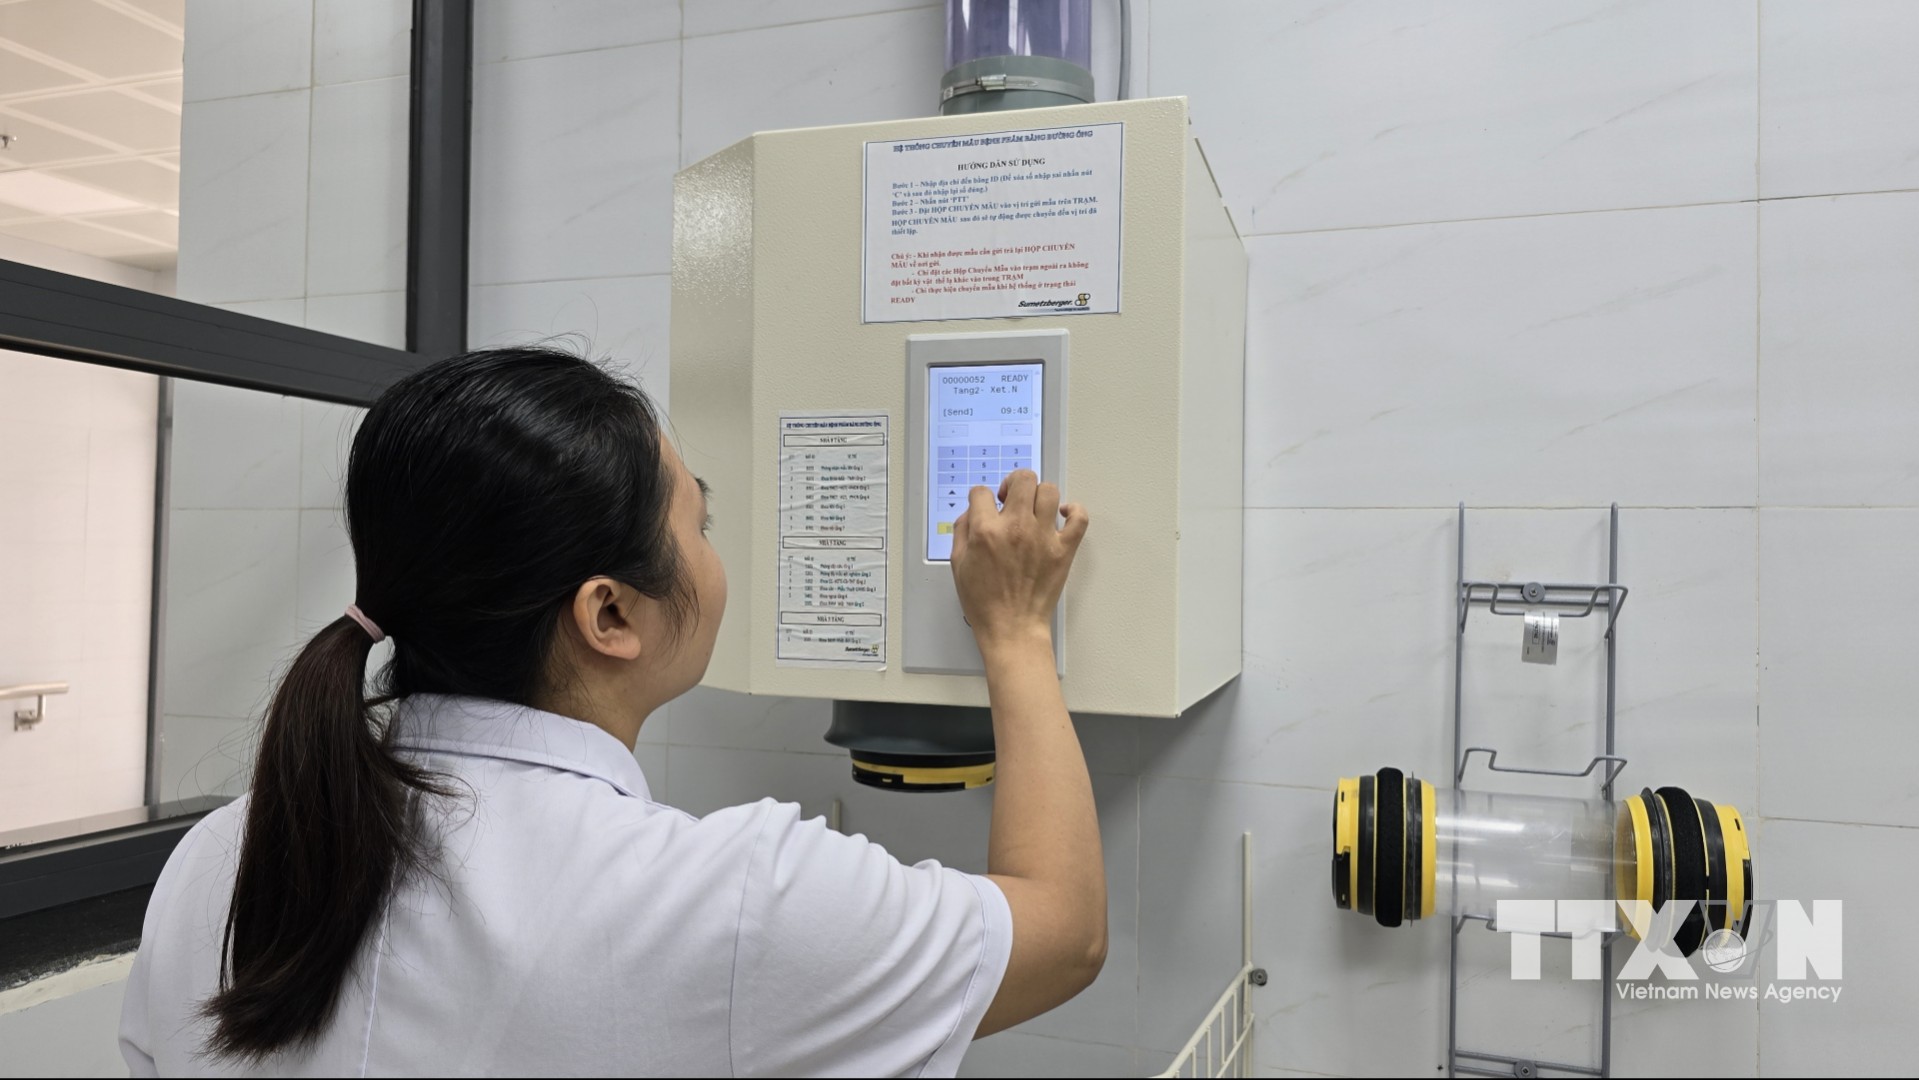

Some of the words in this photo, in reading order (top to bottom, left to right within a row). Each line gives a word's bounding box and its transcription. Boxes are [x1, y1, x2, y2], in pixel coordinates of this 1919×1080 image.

[943, 376, 986, 384] 00000052
[1001, 374, 1028, 382] READY
[990, 385, 1018, 394] Xet.N
[943, 408, 973, 417] [Send]
[1001, 406, 1028, 415] 09:43
